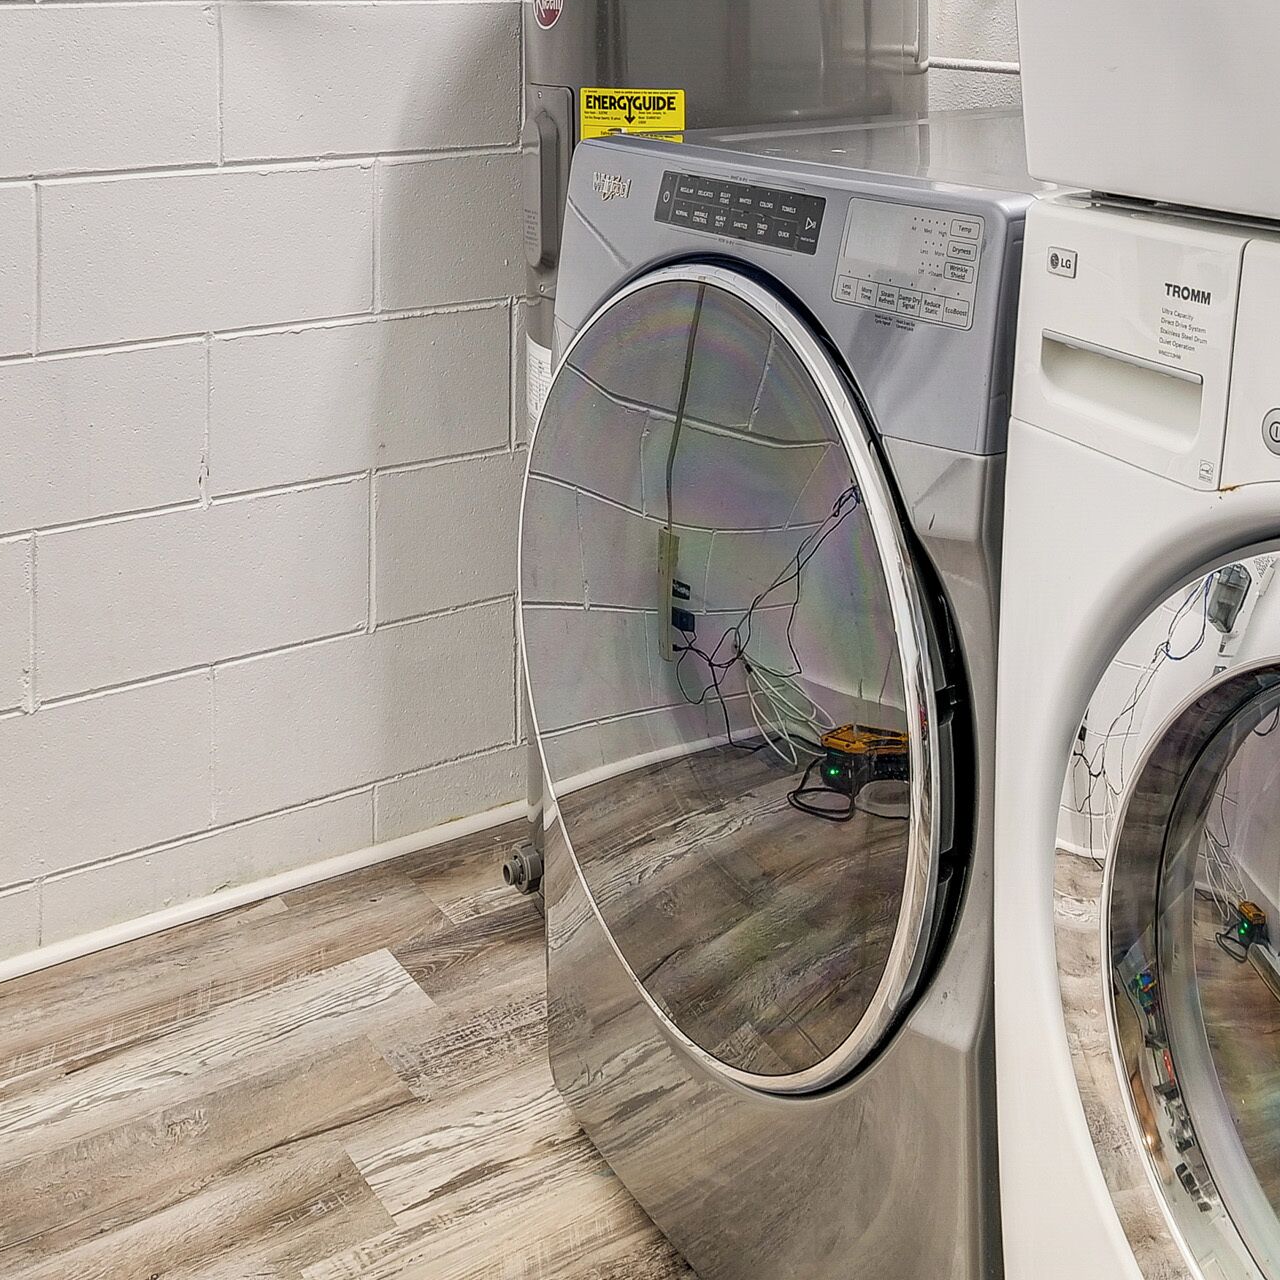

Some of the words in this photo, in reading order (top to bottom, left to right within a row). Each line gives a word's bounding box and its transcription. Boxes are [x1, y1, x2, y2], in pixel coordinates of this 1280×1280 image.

[585, 94, 677, 111] ENERGYGUIDE
[958, 224, 972, 233] Temp
[1060, 258, 1072, 269] LG
[1164, 282, 1212, 306] TROMM
[1194, 335, 1208, 344] Drum
[1172, 340, 1196, 351] Operation
